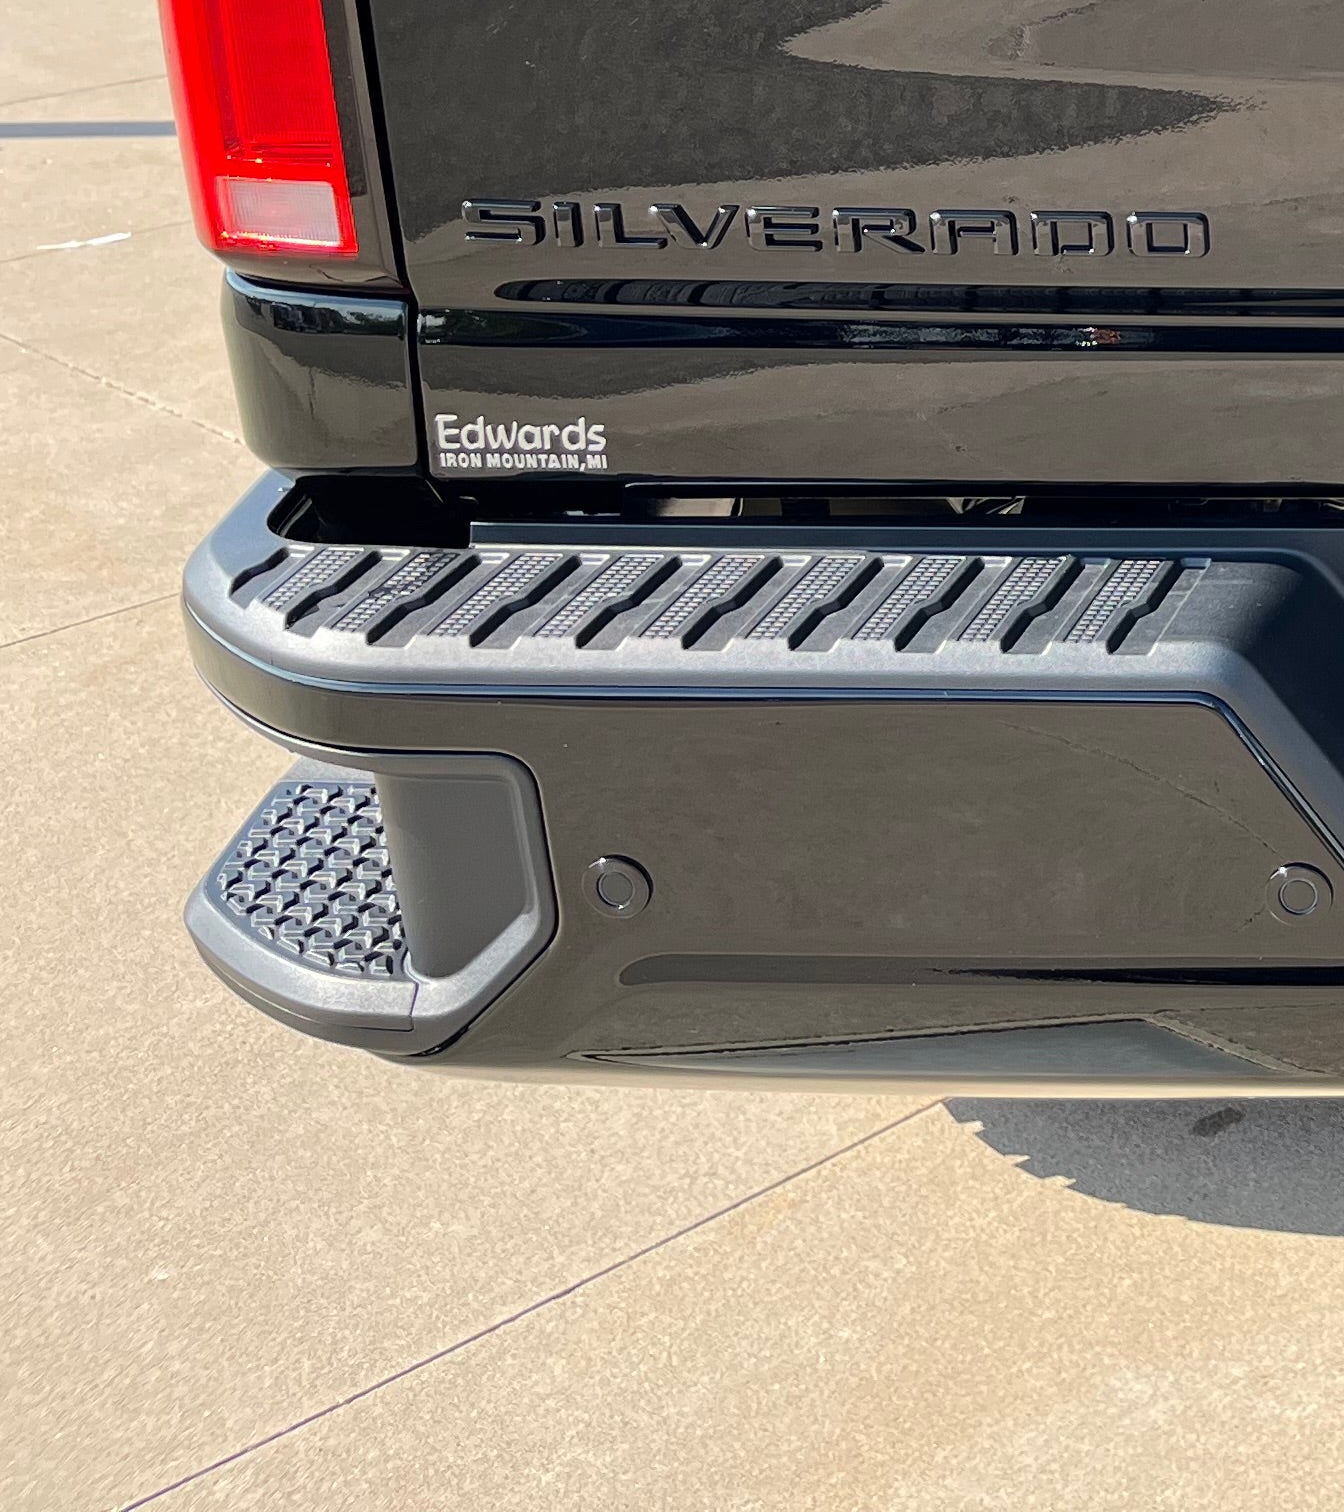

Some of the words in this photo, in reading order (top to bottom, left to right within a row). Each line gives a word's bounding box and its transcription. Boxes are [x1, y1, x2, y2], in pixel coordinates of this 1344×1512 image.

[461, 198, 1211, 257] SILVERADO
[435, 414, 607, 451] Edwards
[440, 453, 482, 468] IRON
